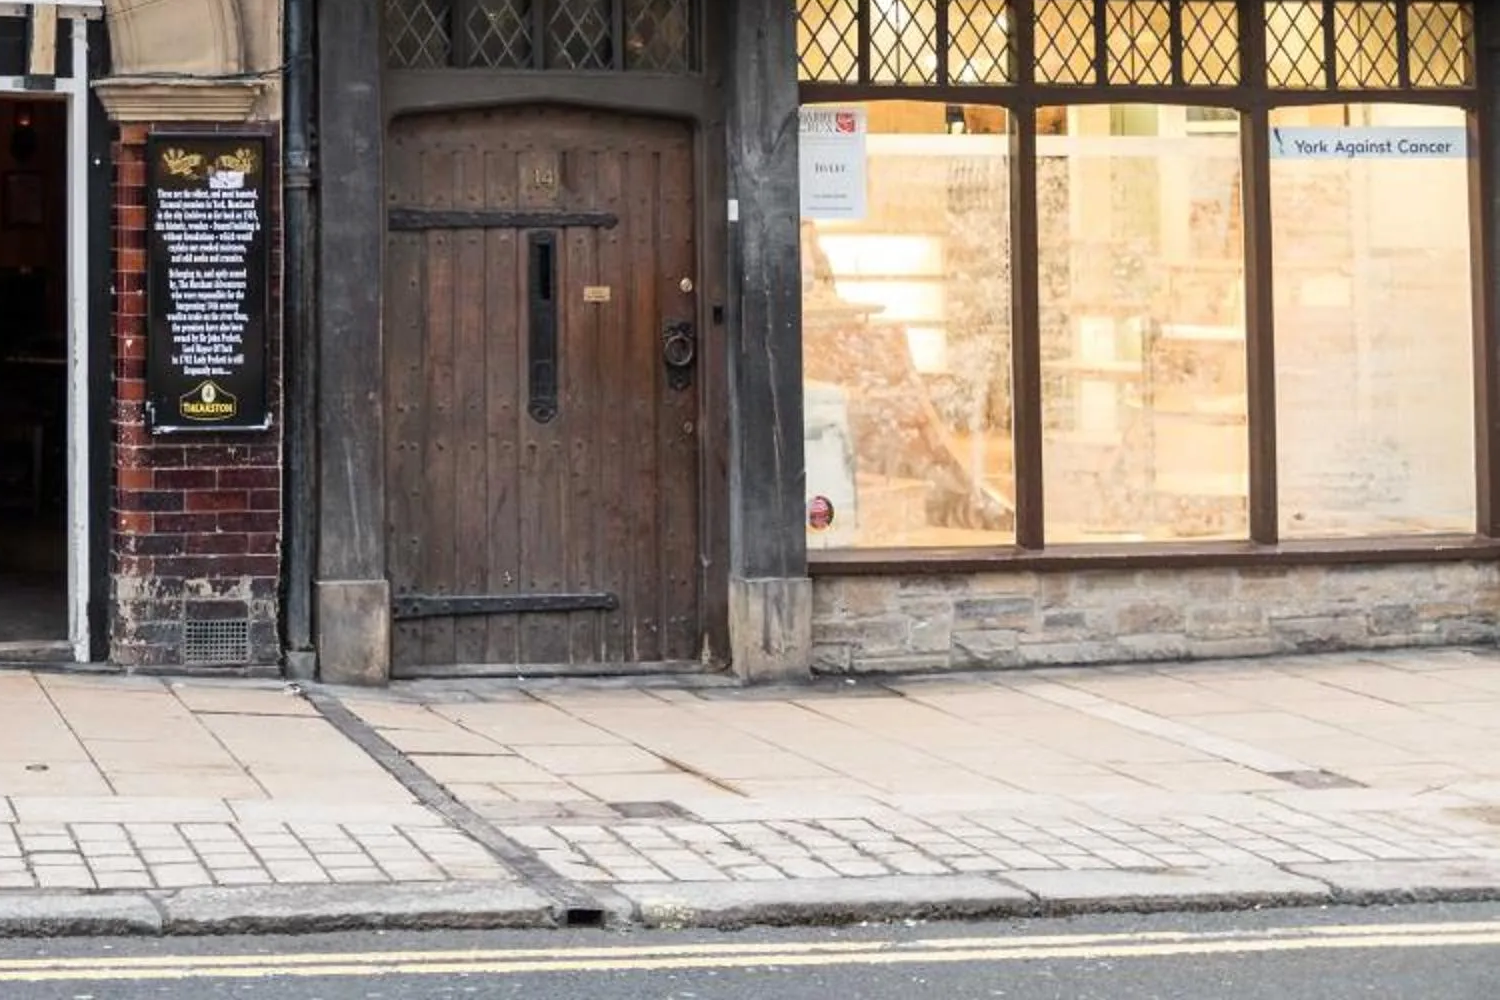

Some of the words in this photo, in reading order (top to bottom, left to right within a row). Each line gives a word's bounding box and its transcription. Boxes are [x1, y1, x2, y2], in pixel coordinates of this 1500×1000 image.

[1295, 139, 1328, 154] York
[1334, 139, 1392, 158] Against
[1397, 139, 1453, 154] Cancer
